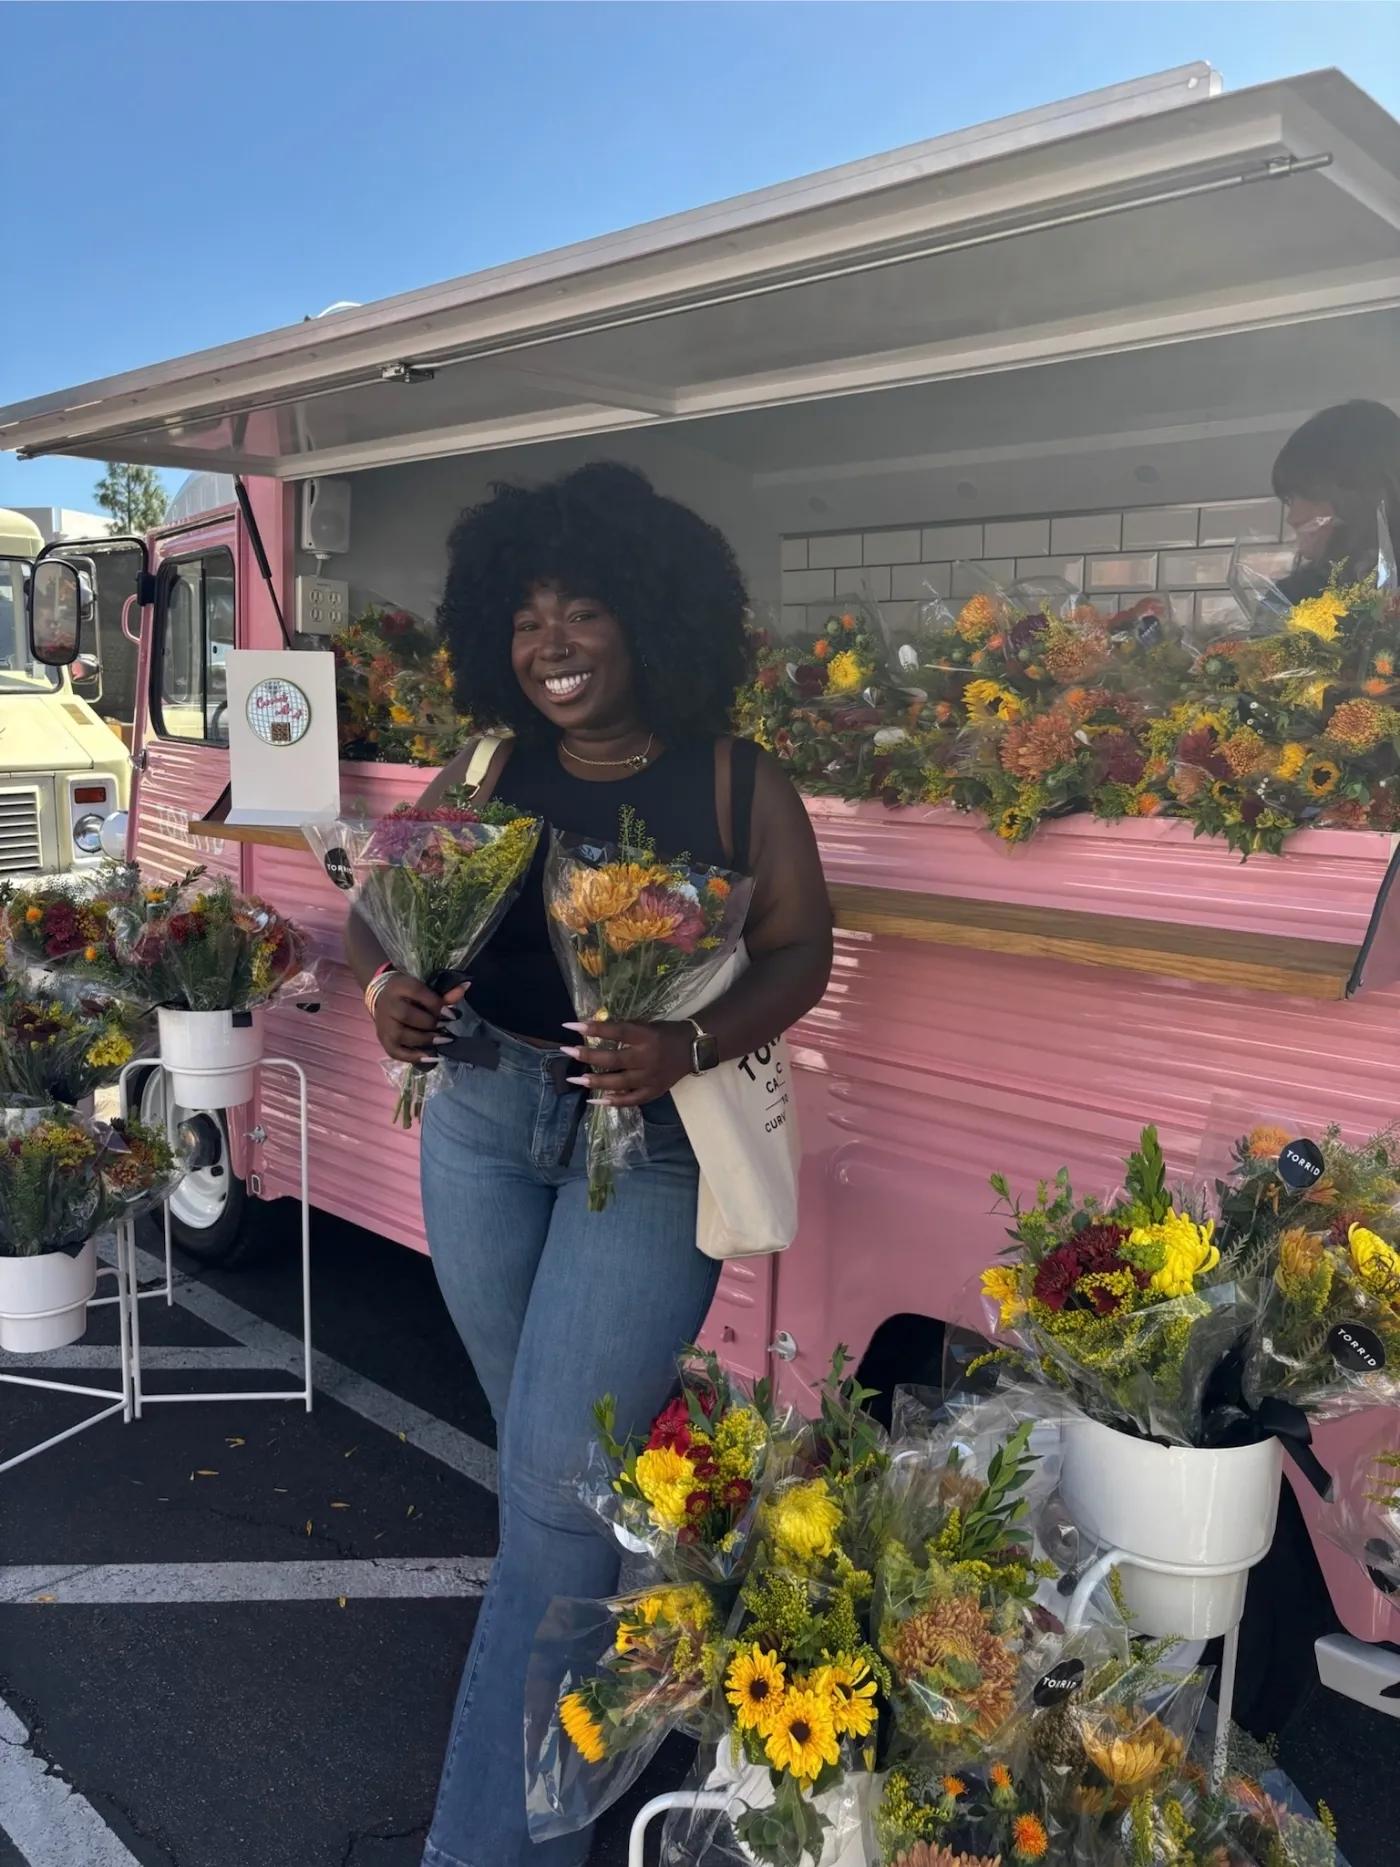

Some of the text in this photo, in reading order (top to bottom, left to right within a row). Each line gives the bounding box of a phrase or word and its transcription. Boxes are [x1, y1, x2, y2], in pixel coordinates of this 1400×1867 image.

[738, 1036, 780, 1081] TO
[1286, 1150, 1320, 1176] TORRID
[1337, 1328, 1376, 1366] TORRID
